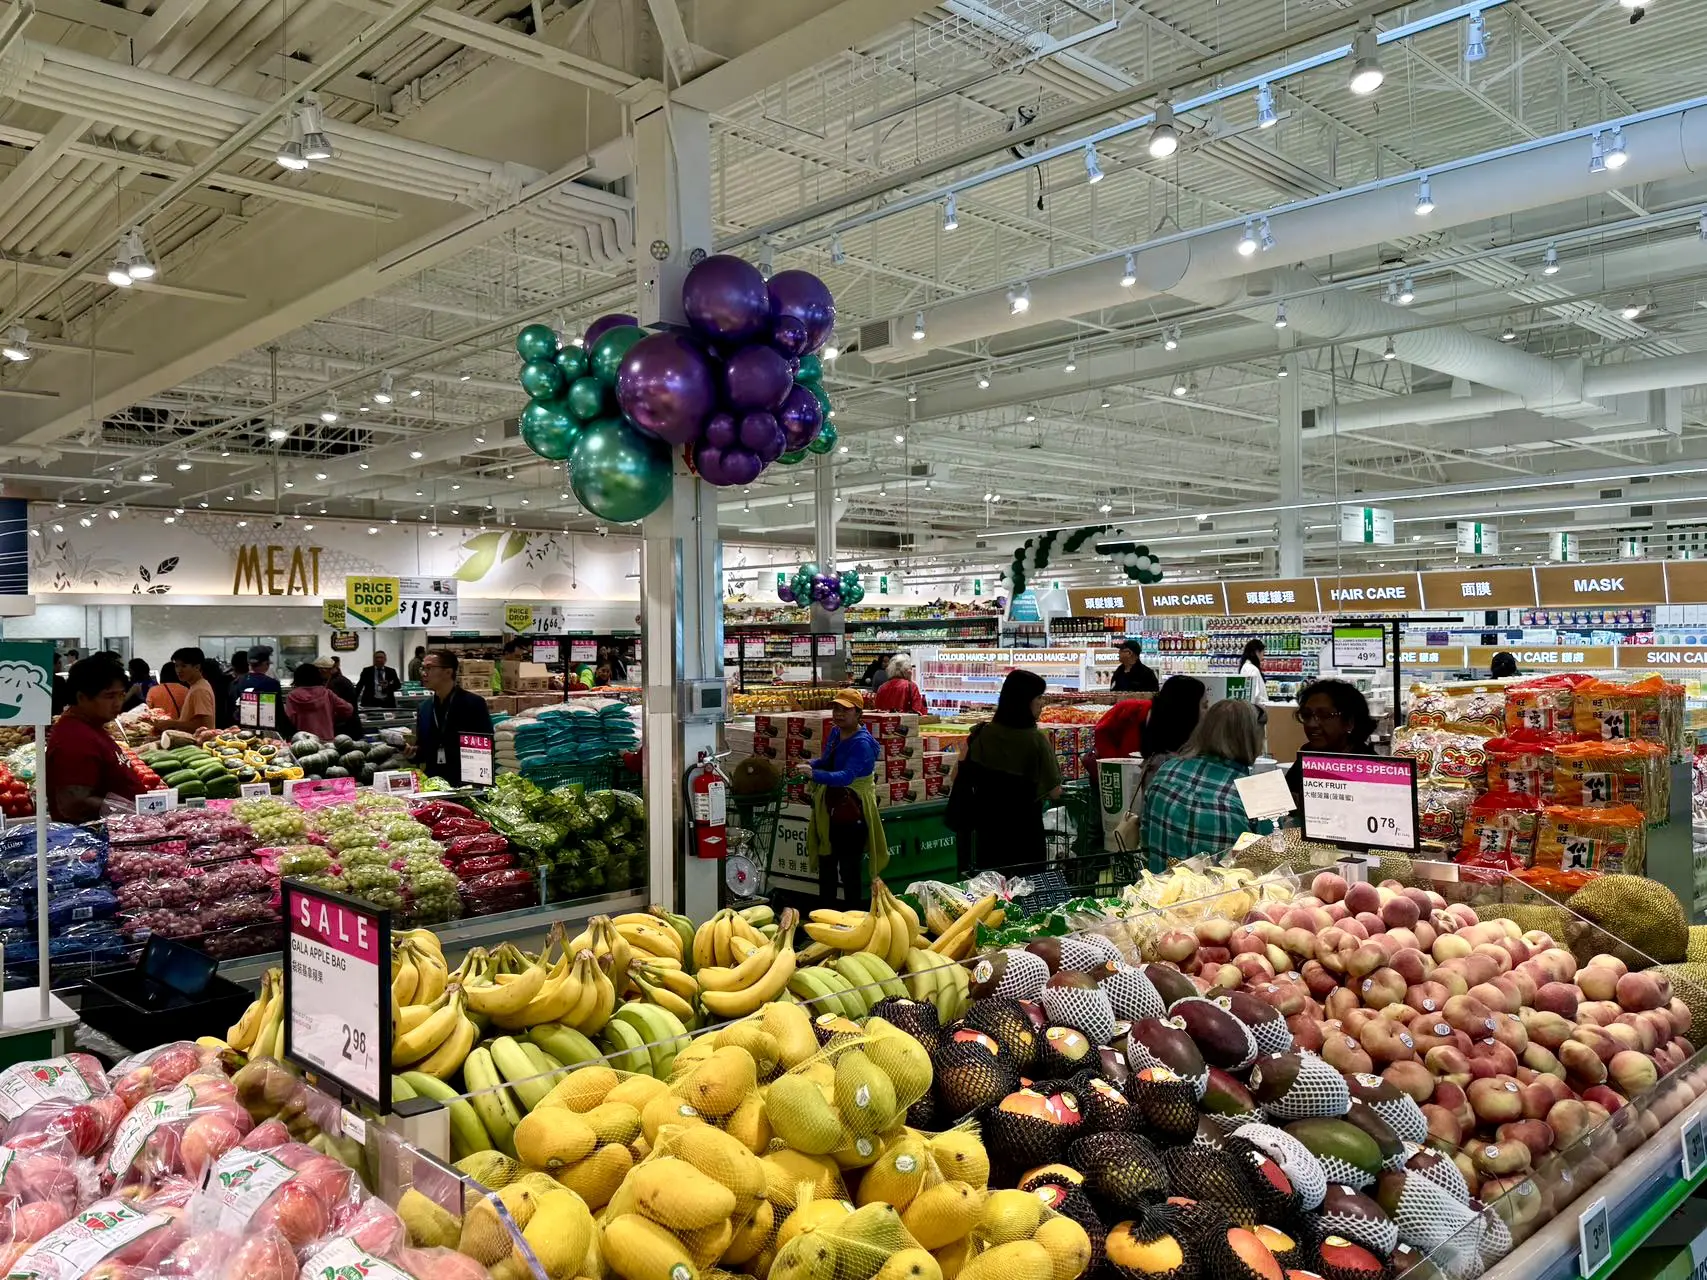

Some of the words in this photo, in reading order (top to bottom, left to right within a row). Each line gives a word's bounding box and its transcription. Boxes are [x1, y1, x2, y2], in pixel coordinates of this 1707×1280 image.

[233, 544, 323, 595] MEAT
[354, 582, 392, 594] PRICE
[1461, 582, 1492, 596] 面膜
[1574, 578, 1624, 592] MASK
[355, 594, 393, 605] DROP
[1331, 589, 1364, 600] HAIR
[1367, 587, 1406, 599] CARE
[1153, 596, 1180, 606] HAIR
[1182, 594, 1214, 605] CARE
[939, 653, 965, 661] COLOUR
[966, 653, 996, 661] MAKE-UP
[1014, 653, 1043, 661] COLOUR
[1044, 653, 1078, 661] MAKE-UP
[1524, 652, 1558, 662] CARE
[1647, 652, 1680, 663] SKIN
[1684, 652, 1707, 663] CA
[464, 736, 488, 747] SALE
[1302, 760, 1363, 773] MANAGER'S
[1366, 765, 1411, 776] SPECIAL
[1304, 780, 1324, 788] JACK
[778, 825, 807, 843] Speci
[940, 836, 956, 848] T&T
[301, 897, 369, 950] SALE
[291, 938, 309, 956] GALA
[310, 946, 330, 965] APPLE
[331, 954, 346, 971] BAG
